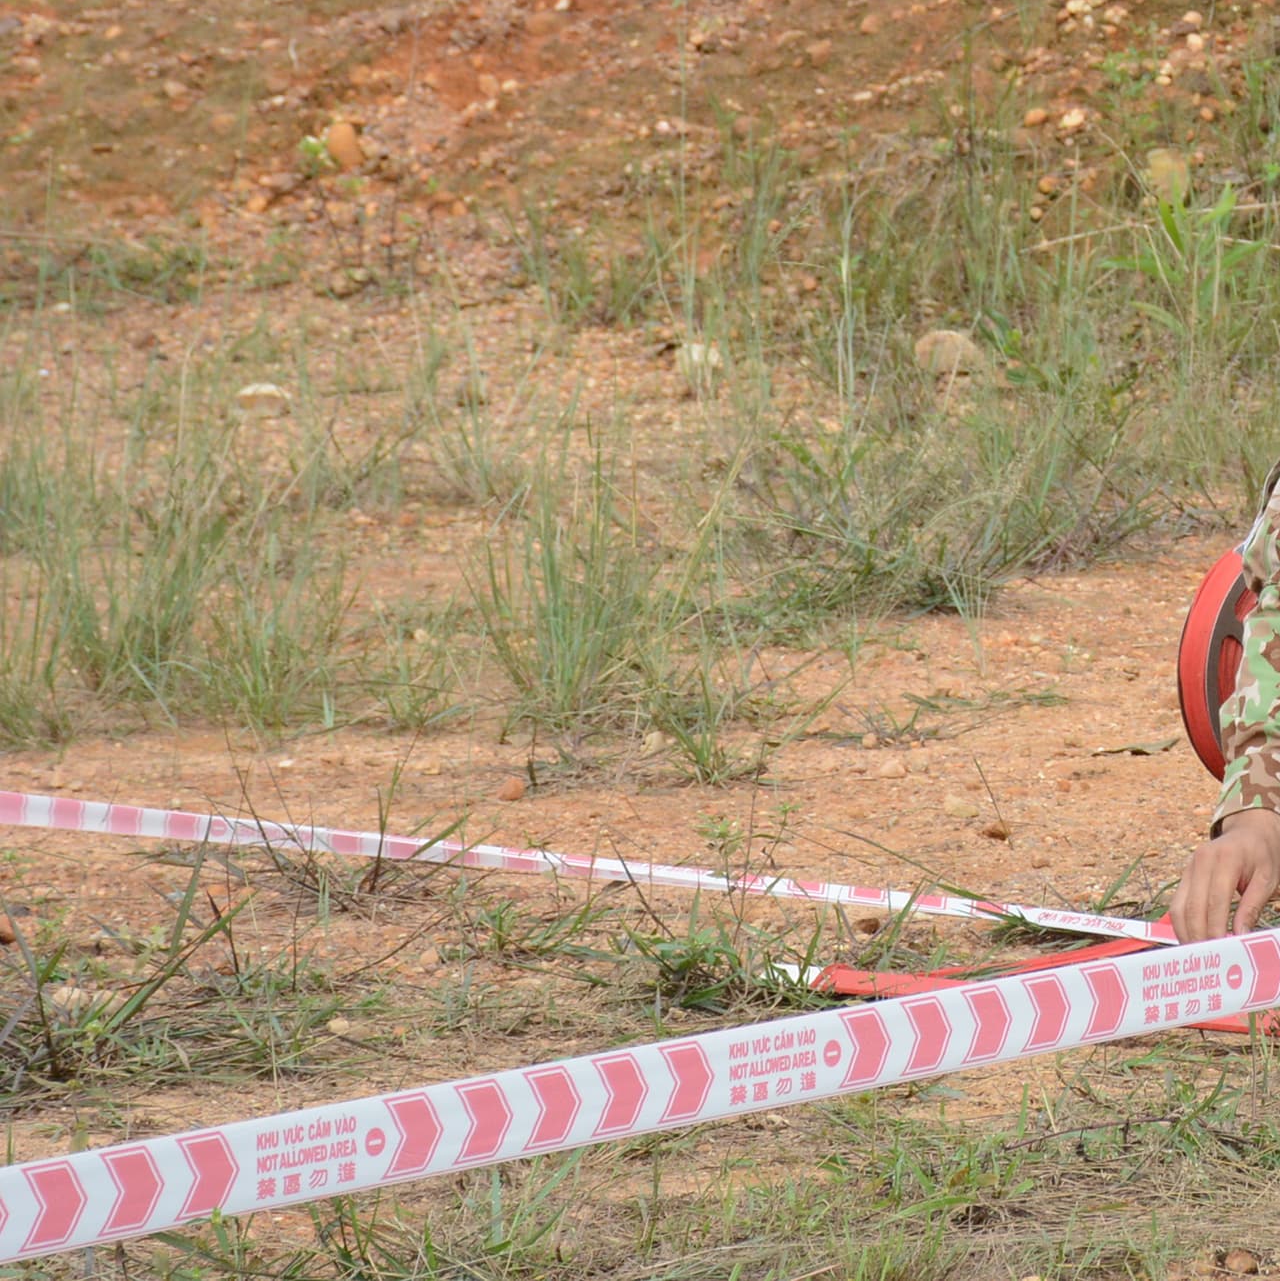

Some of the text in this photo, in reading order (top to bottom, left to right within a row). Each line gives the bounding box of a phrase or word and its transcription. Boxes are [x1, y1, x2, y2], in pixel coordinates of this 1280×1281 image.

[729, 1051, 817, 1081] NOT ALLOWED AREA
[256, 1131, 279, 1151] KHU
[256, 1139, 357, 1174] NOT ALLOWED AREA
